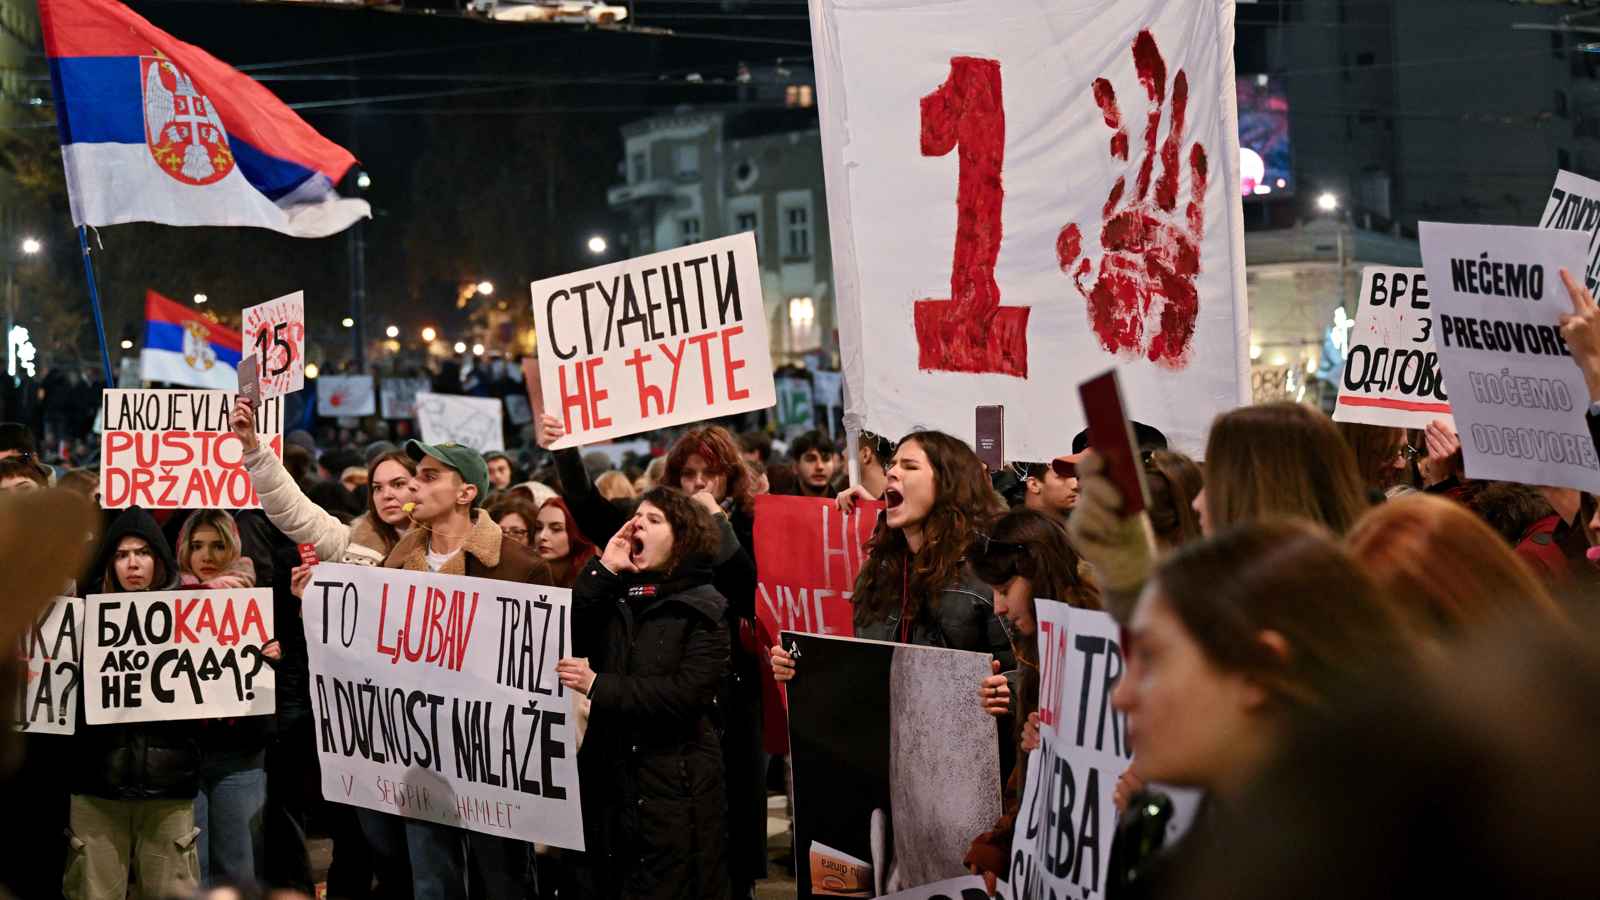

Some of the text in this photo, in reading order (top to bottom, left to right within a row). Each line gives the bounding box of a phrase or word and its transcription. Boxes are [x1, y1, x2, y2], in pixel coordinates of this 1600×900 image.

[914, 56, 1031, 379] 1
[1451, 251, 1544, 301] NEĆEMO
[546, 250, 743, 360] СТУДЕНТИ
[255, 321, 292, 378] 15
[558, 357, 612, 435] НЕ
[624, 325, 750, 418] ЋУТЕ
[1468, 367, 1574, 412] HOĆEMO
[103, 393, 160, 431] LAKO
[105, 467, 259, 507] DRŽAVO
[98, 598, 269, 648] БЛОКАДА
[314, 581, 359, 648] TO
[496, 594, 566, 698] TRAŽI
[100, 649, 150, 672] АКО
[102, 644, 263, 709] НЕ САДА?
[316, 674, 567, 801] A DUŽNOST NALAŽE
